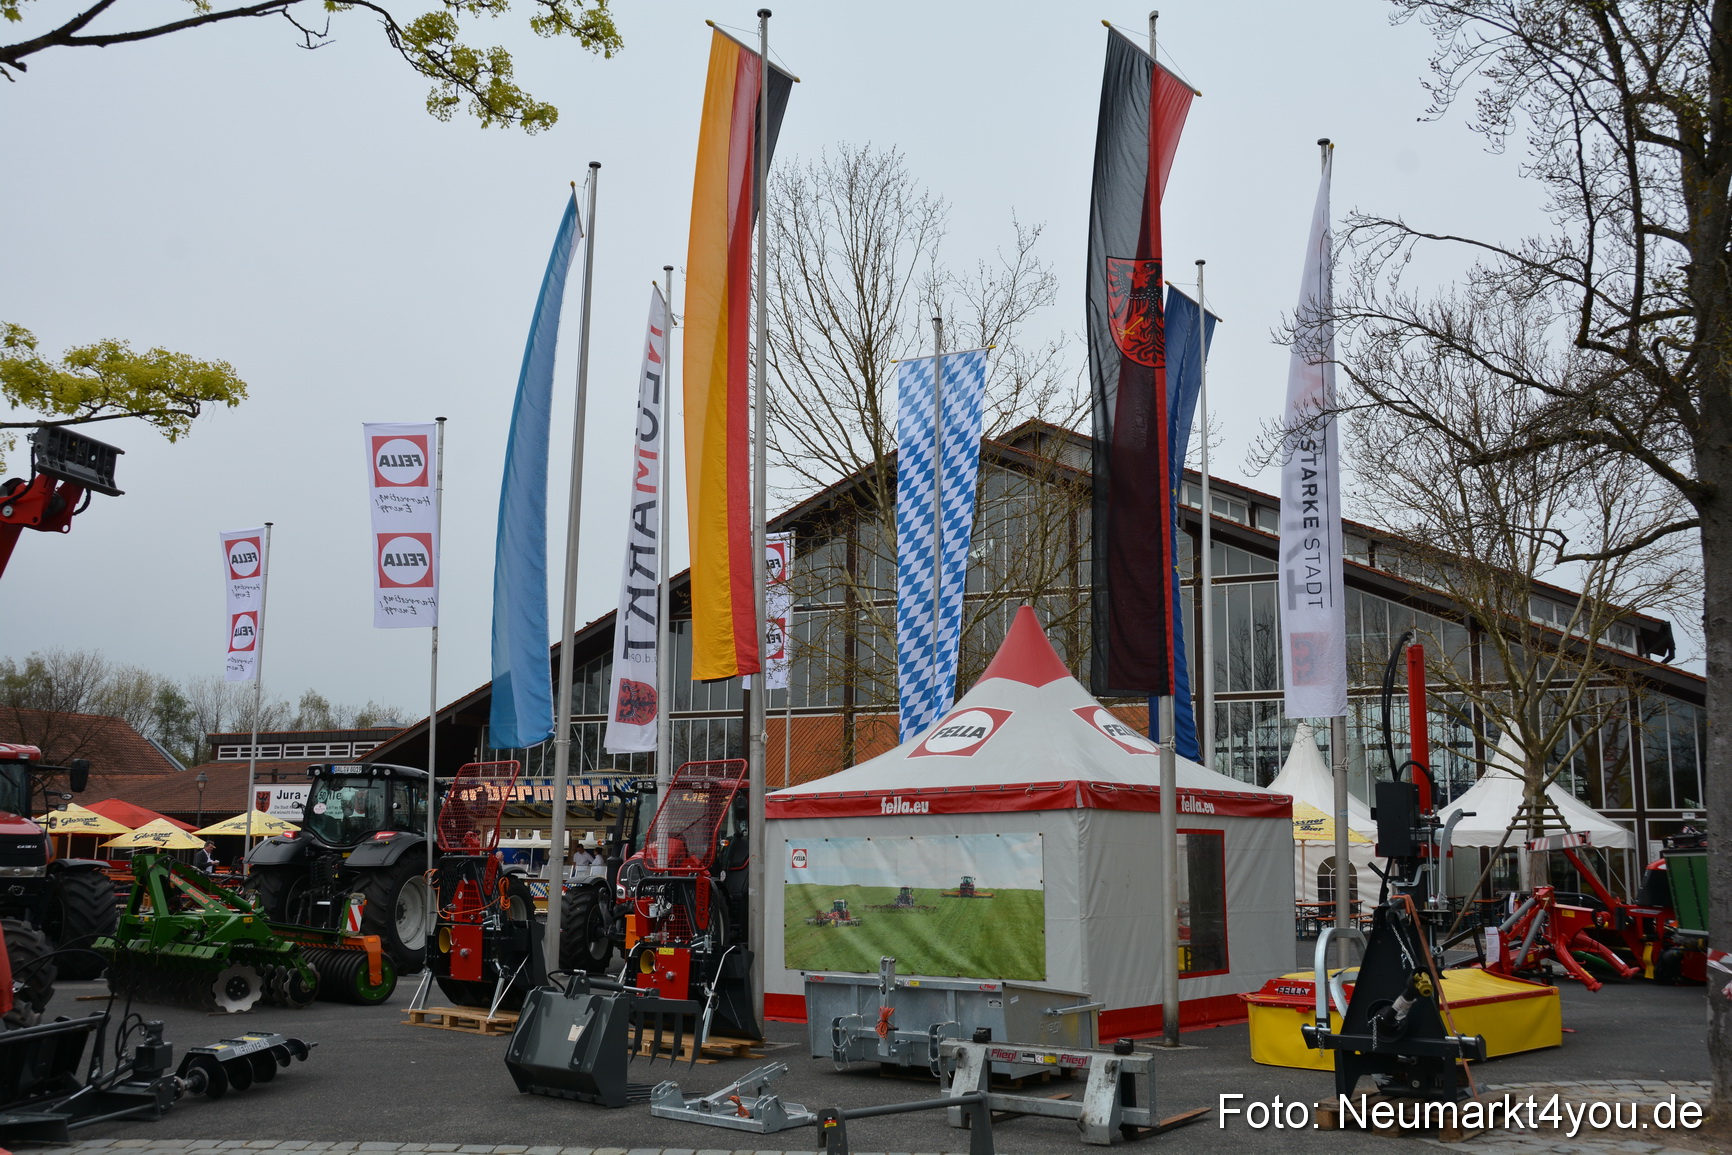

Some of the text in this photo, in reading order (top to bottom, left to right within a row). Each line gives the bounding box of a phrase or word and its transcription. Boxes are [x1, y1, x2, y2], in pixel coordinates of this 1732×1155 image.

[1300, 439, 1324, 609] STARKE STADT
[930, 725, 987, 740] FELLA
[276, 790, 301, 799] Jura
[881, 796, 929, 814] fella.eu
[1181, 795, 1215, 814] fella.eu
[1277, 986, 1307, 996] FELLA
[233, 1039, 270, 1056] MEHRTENS
[991, 1048, 1018, 1062] Fliegl
[1060, 1054, 1088, 1069] Fliegl
